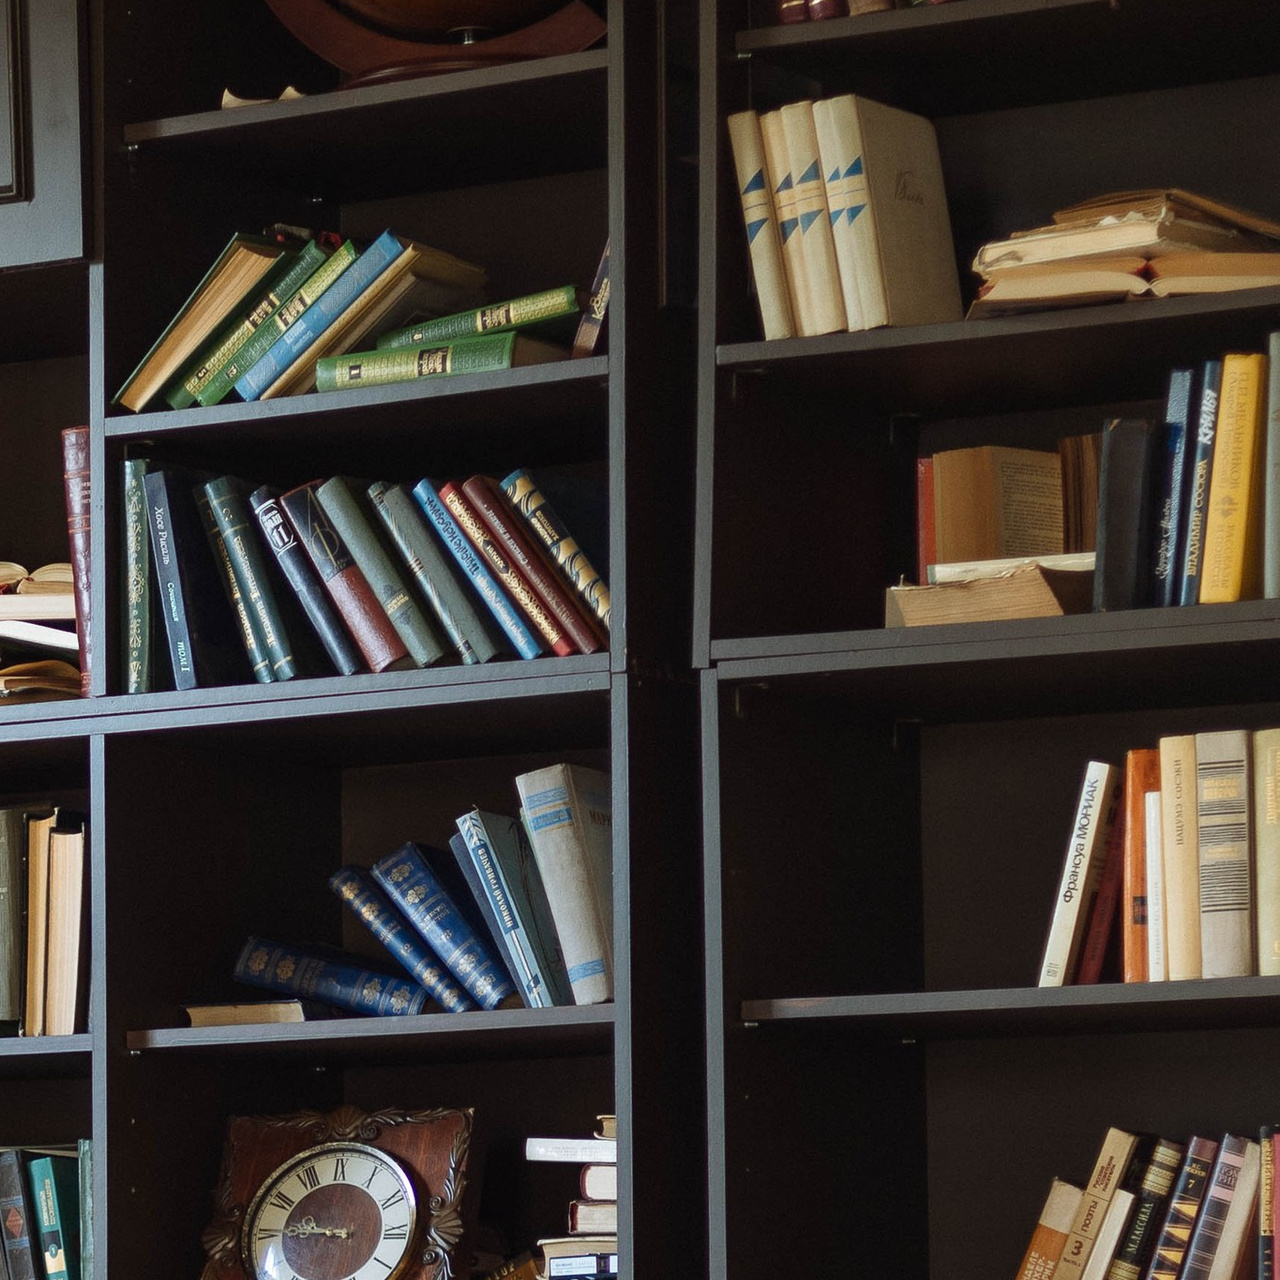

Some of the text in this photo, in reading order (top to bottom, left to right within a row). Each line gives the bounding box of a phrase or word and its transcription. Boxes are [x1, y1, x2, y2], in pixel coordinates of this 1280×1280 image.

[153, 505, 164, 529] Хосе
[1185, 458, 1208, 576] ВЛАДИМИР СОСЮРА
[157, 530, 169, 565] Рисаль
[175, 641, 186, 665] том
[1174, 759, 1182, 799] СОСЭКИ
[1061, 777, 1100, 903] Франсуа МОРИАК
[477, 847, 514, 927] НИКОЛАЙ ГРИБАЧЕВ
[333, 1158, 348, 1181] IX
[1188, 1179, 1195, 1189] 7
[1080, 1199, 1098, 1233] ПОЭТЫ
